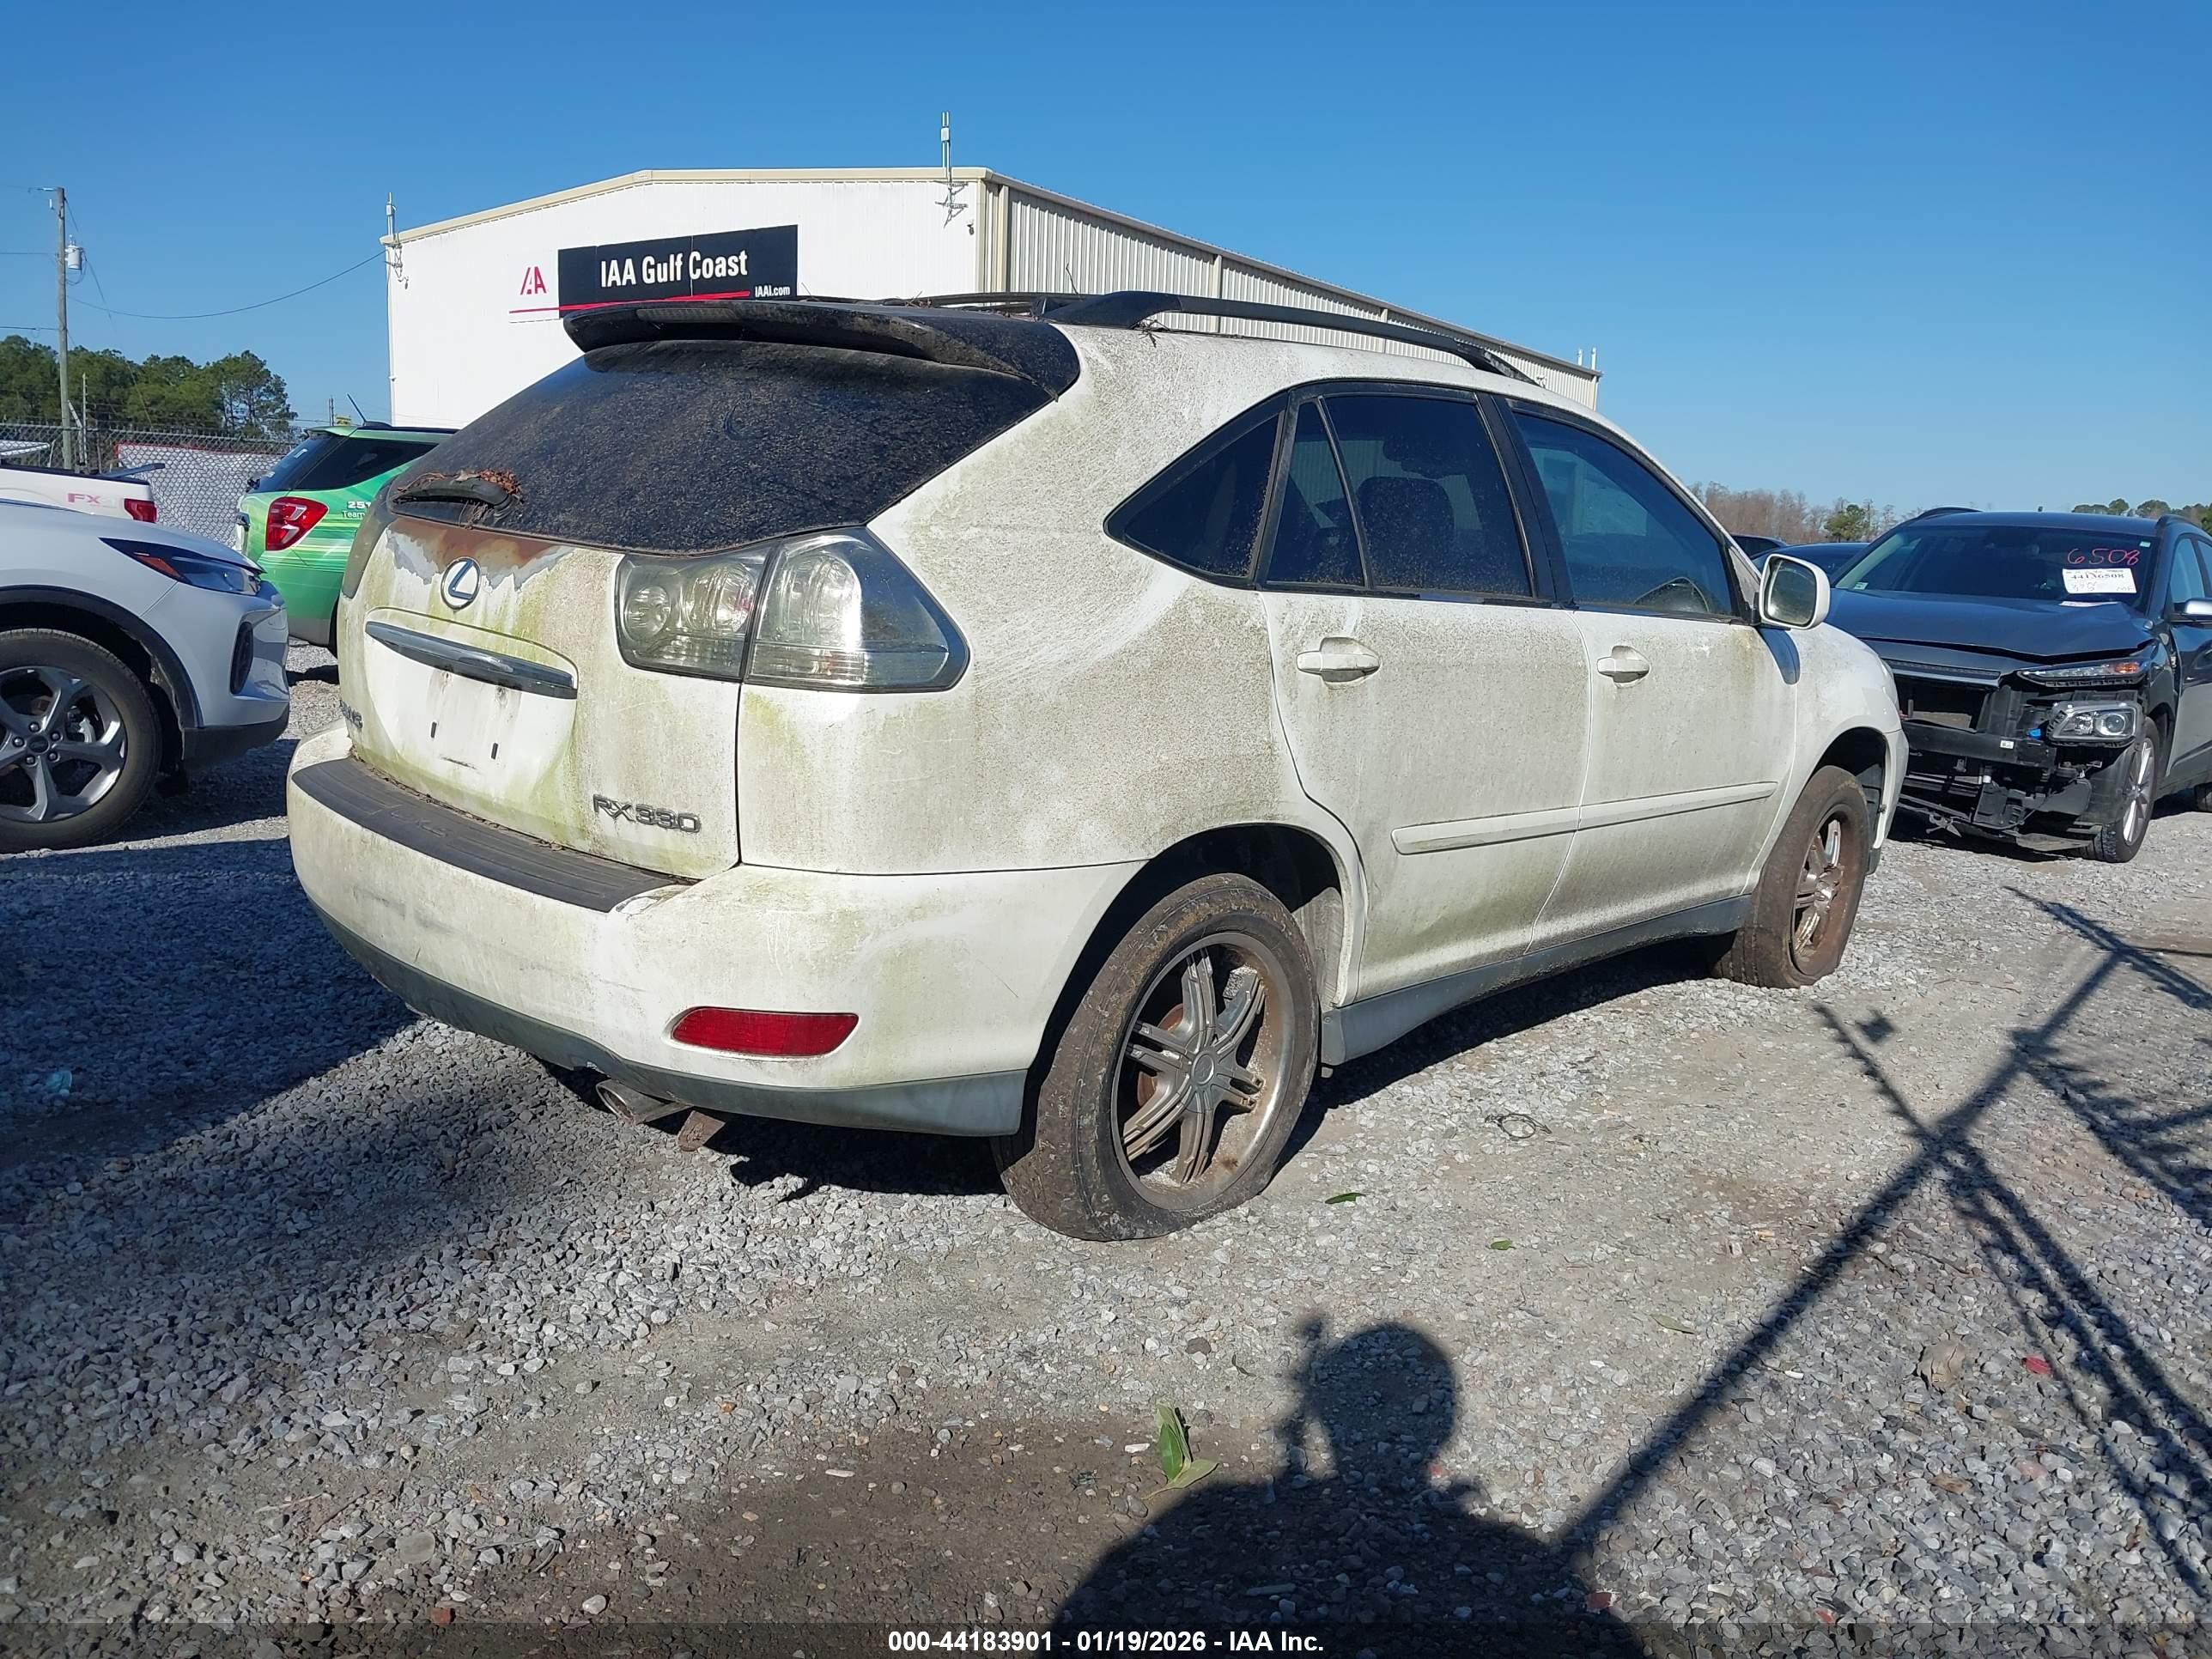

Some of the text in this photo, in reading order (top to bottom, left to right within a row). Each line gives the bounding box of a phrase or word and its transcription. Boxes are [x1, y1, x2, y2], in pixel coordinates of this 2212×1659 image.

[600, 250, 748, 288] IAA Gulf Coast
[2067, 548, 2141, 566] 6508
